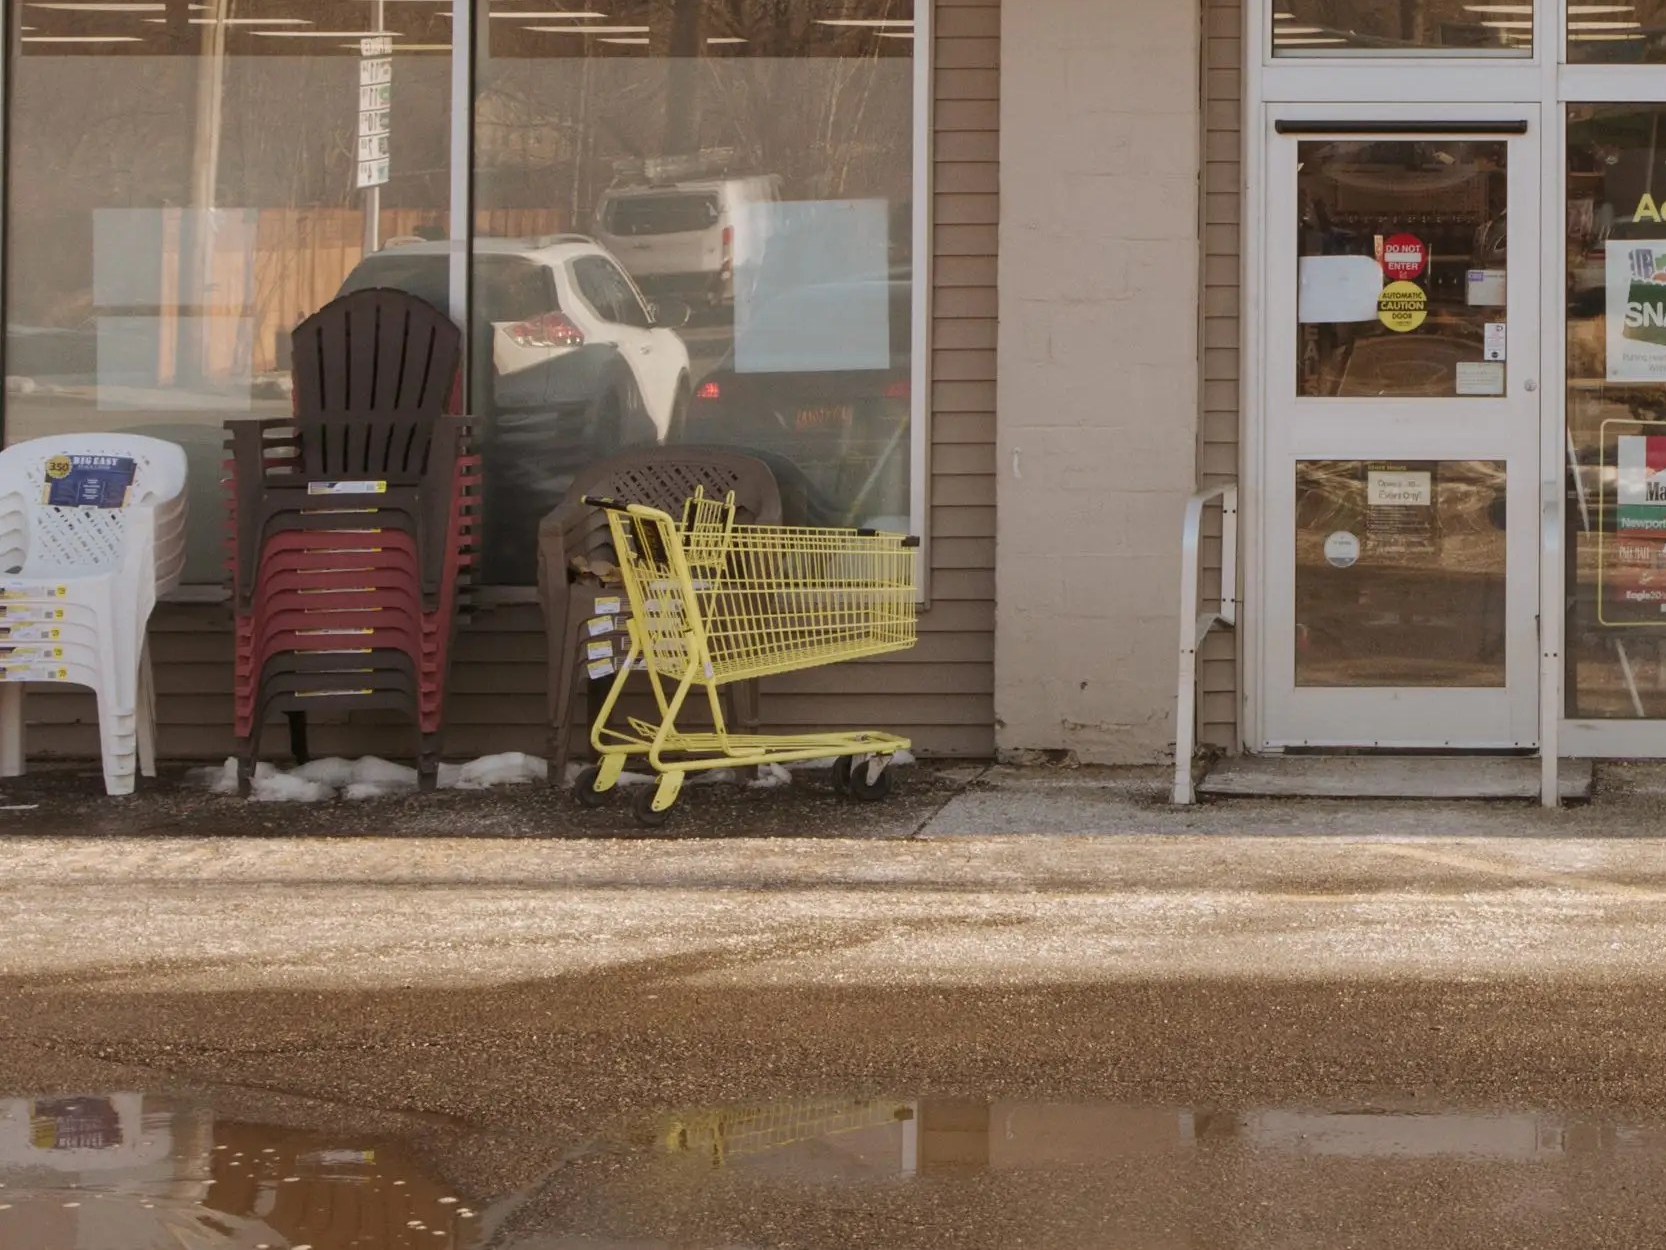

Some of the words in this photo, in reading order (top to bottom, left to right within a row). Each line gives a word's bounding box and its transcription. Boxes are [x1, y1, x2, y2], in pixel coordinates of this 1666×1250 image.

[1385, 244, 1399, 252] DO
[1402, 244, 1421, 252] NOT
[1388, 262, 1418, 270] ENTER
[1380, 301, 1425, 310] CAUTION
[1392, 312, 1412, 320] DOOR
[73, 457, 91, 466] BIG
[93, 457, 119, 467] EASY
[49, 462, 70, 472] 350
[1621, 517, 1666, 529] Newport
